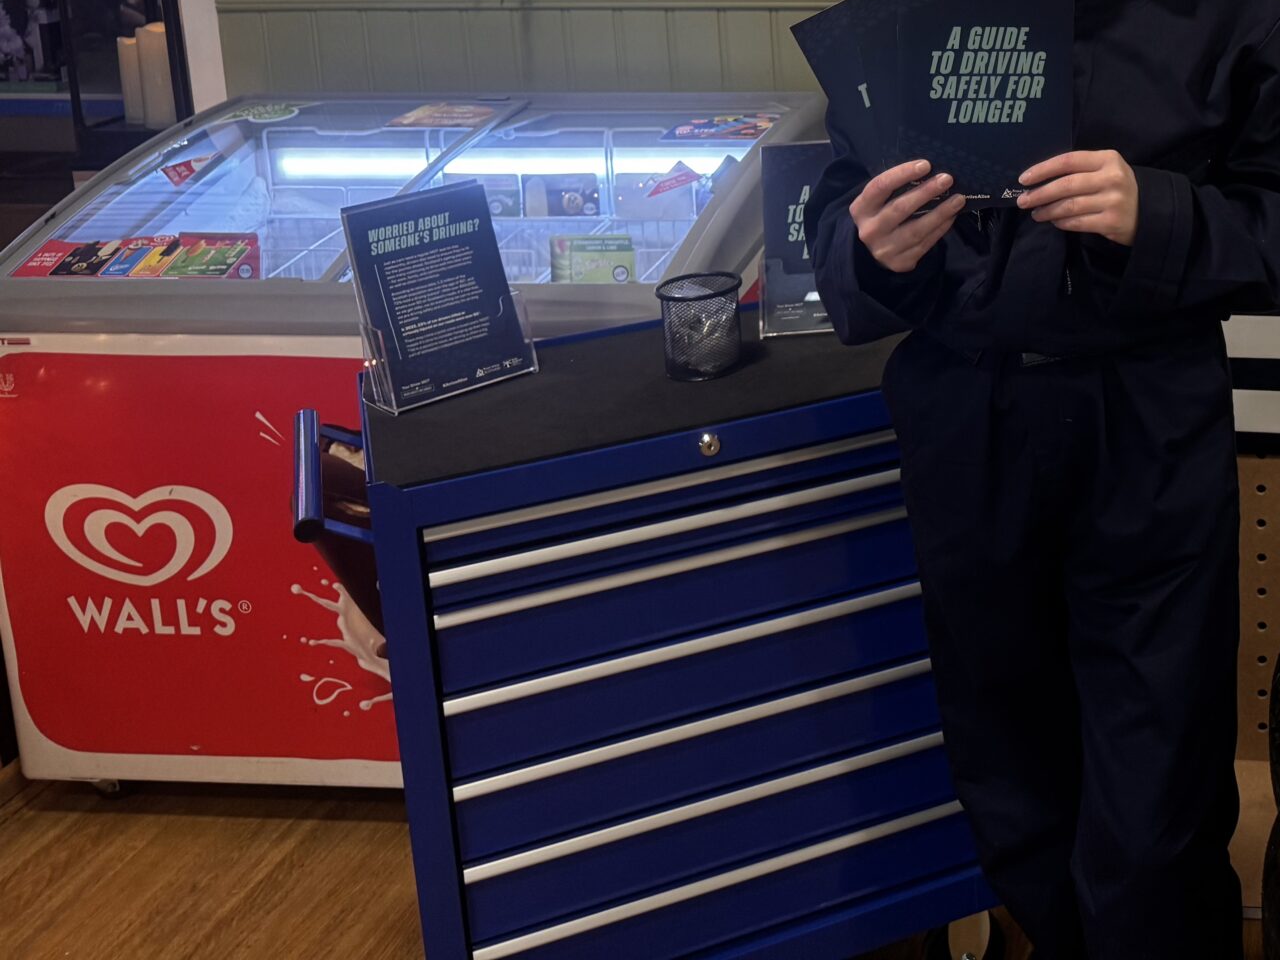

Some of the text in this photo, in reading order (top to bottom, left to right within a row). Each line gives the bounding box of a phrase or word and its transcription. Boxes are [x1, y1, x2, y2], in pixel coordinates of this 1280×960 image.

[946, 26, 1029, 50] A GUIDE
[929, 51, 1047, 75] TO DRIVING
[857, 82, 871, 109] T
[929, 76, 1046, 99] SAFELY FOR
[947, 100, 1027, 124] LONGER
[799, 185, 810, 203] A
[787, 204, 805, 223] TO
[368, 212, 450, 243] WORRIED ABOUT
[371, 218, 480, 256] SOMEONE'S DRIVING?
[67, 595, 236, 637] WALL'S
